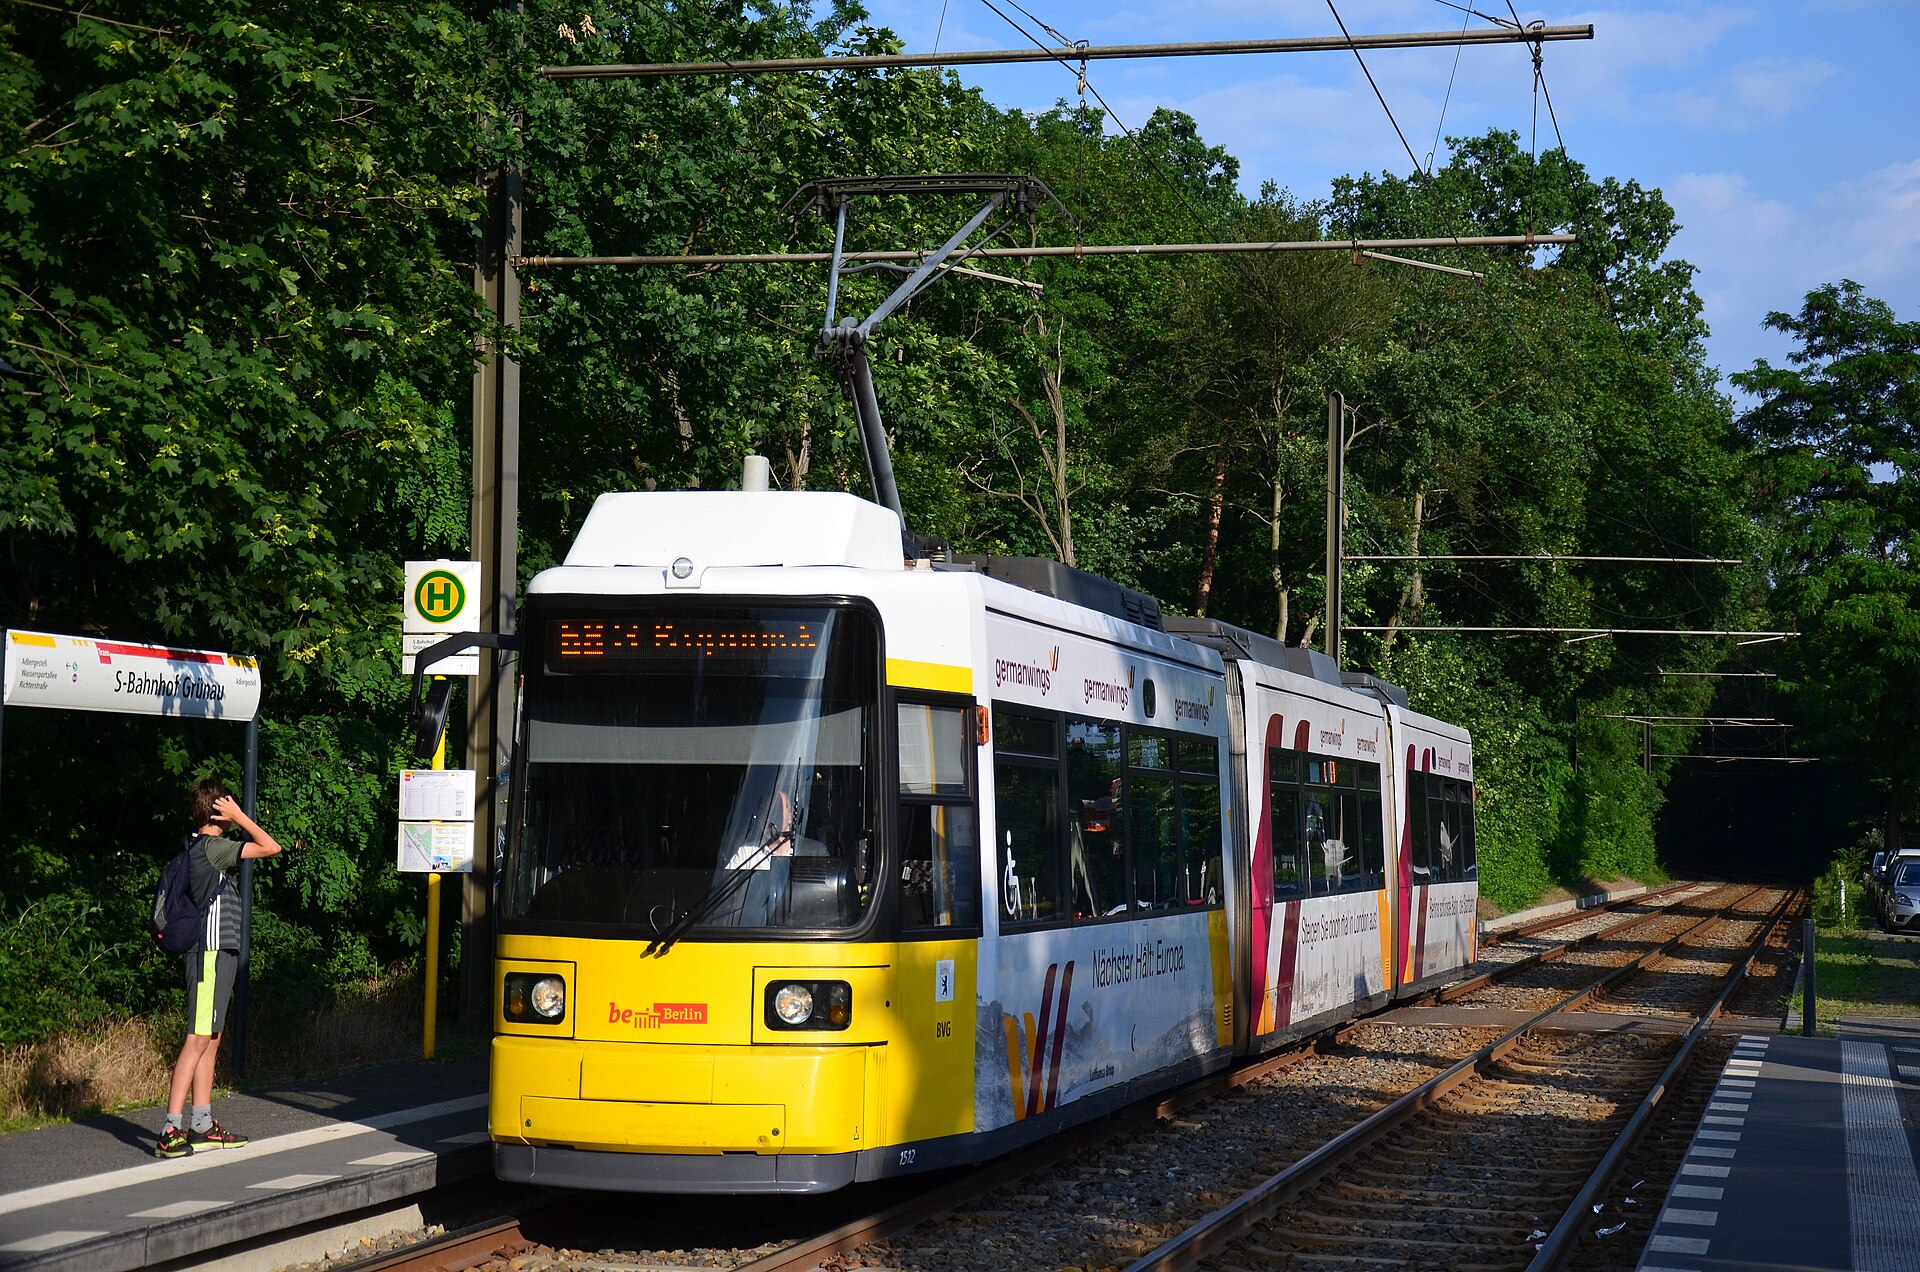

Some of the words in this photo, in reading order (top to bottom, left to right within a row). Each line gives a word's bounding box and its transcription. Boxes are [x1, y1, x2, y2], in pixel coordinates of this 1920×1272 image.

[427, 583, 452, 610] H
[21, 657, 48, 669] Adlergestell
[995, 658, 1051, 696] germanwings
[114, 670, 180, 698] S-Bahnhof
[181, 676, 225, 701] Grünau
[1083, 678, 1129, 711] germanwings
[1174, 697, 1210, 727] germanwings
[1092, 947, 1134, 989] Nächster
[1156, 940, 1186, 982] Europa.
[608, 1002, 633, 1024] be
[663, 1007, 702, 1021] Berlin
[936, 1021, 951, 1038] BVG
[899, 1149, 916, 1166] 1512
